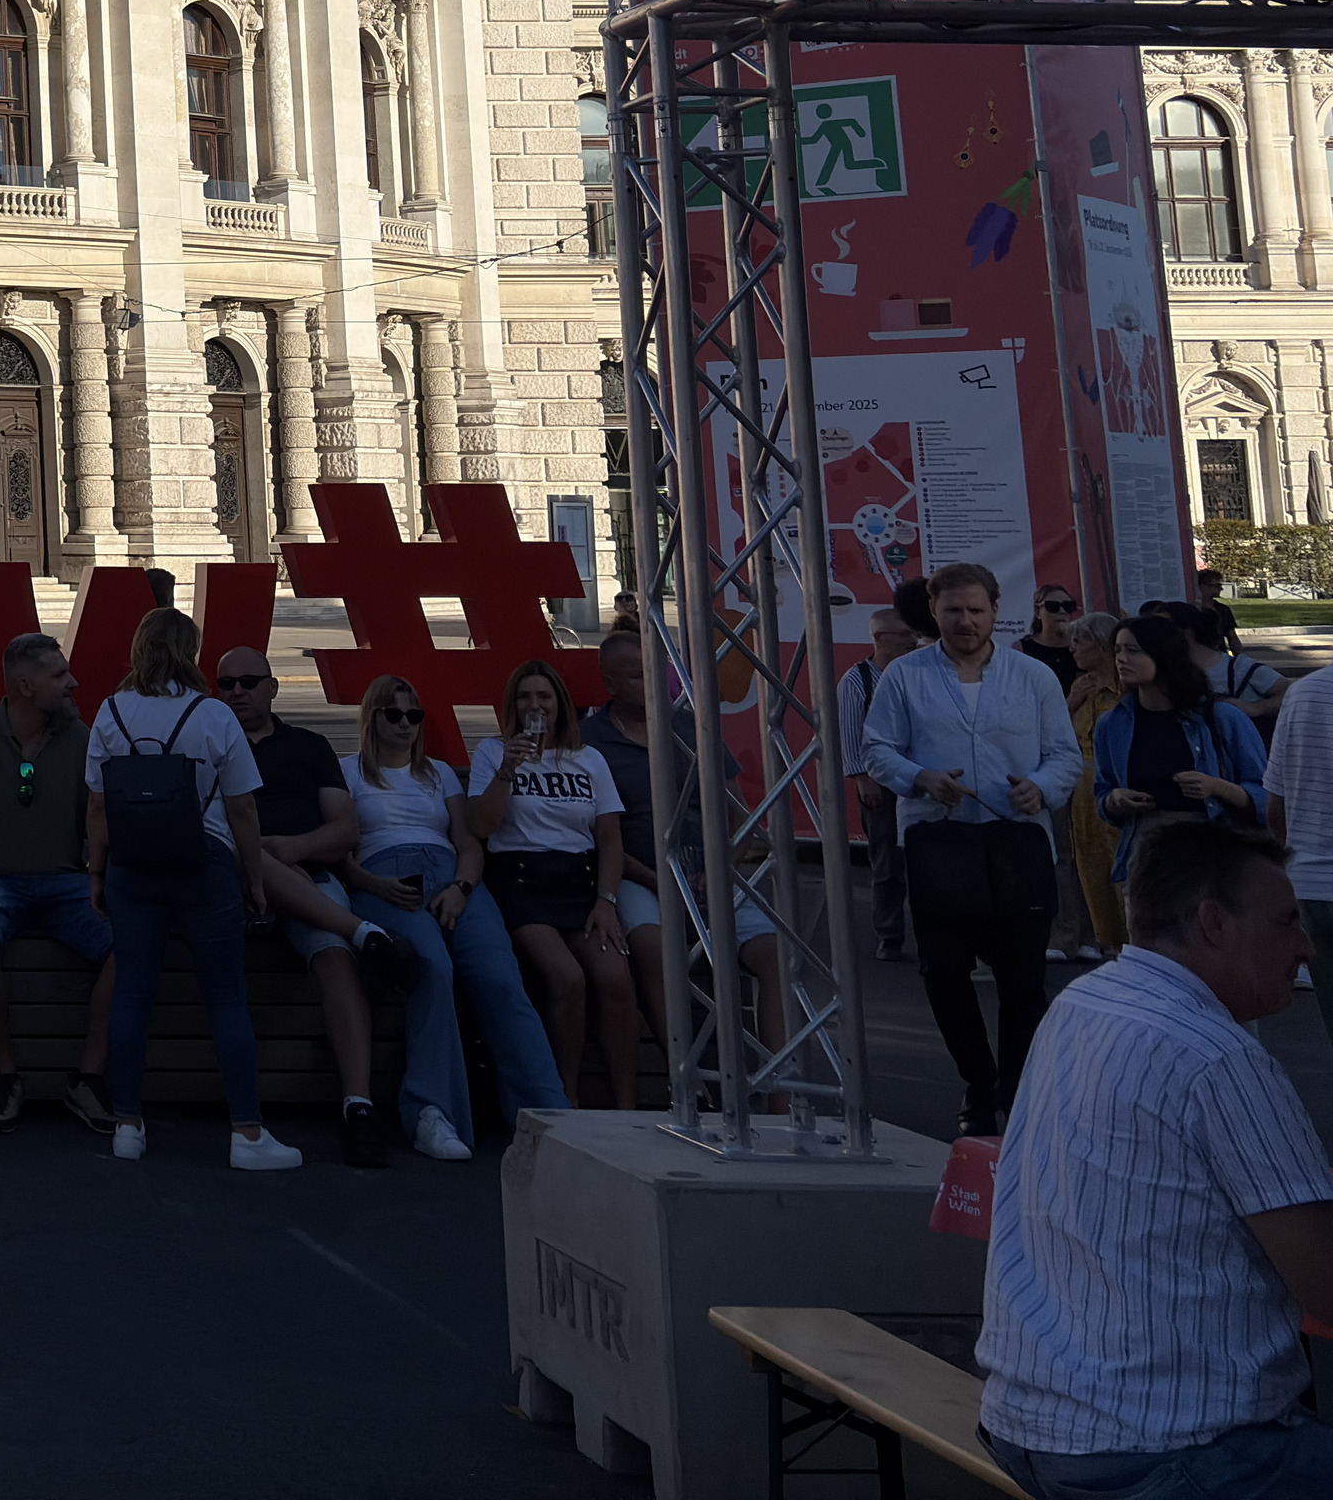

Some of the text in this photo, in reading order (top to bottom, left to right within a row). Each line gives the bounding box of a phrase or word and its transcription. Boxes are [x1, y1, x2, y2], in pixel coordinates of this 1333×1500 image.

[1083, 208, 1129, 240] Platzordnung
[849, 399, 878, 410] 2025
[512, 772, 592, 799] PARIS
[951, 1185, 979, 1202] Stadt
[949, 1197, 981, 1216] Wien
